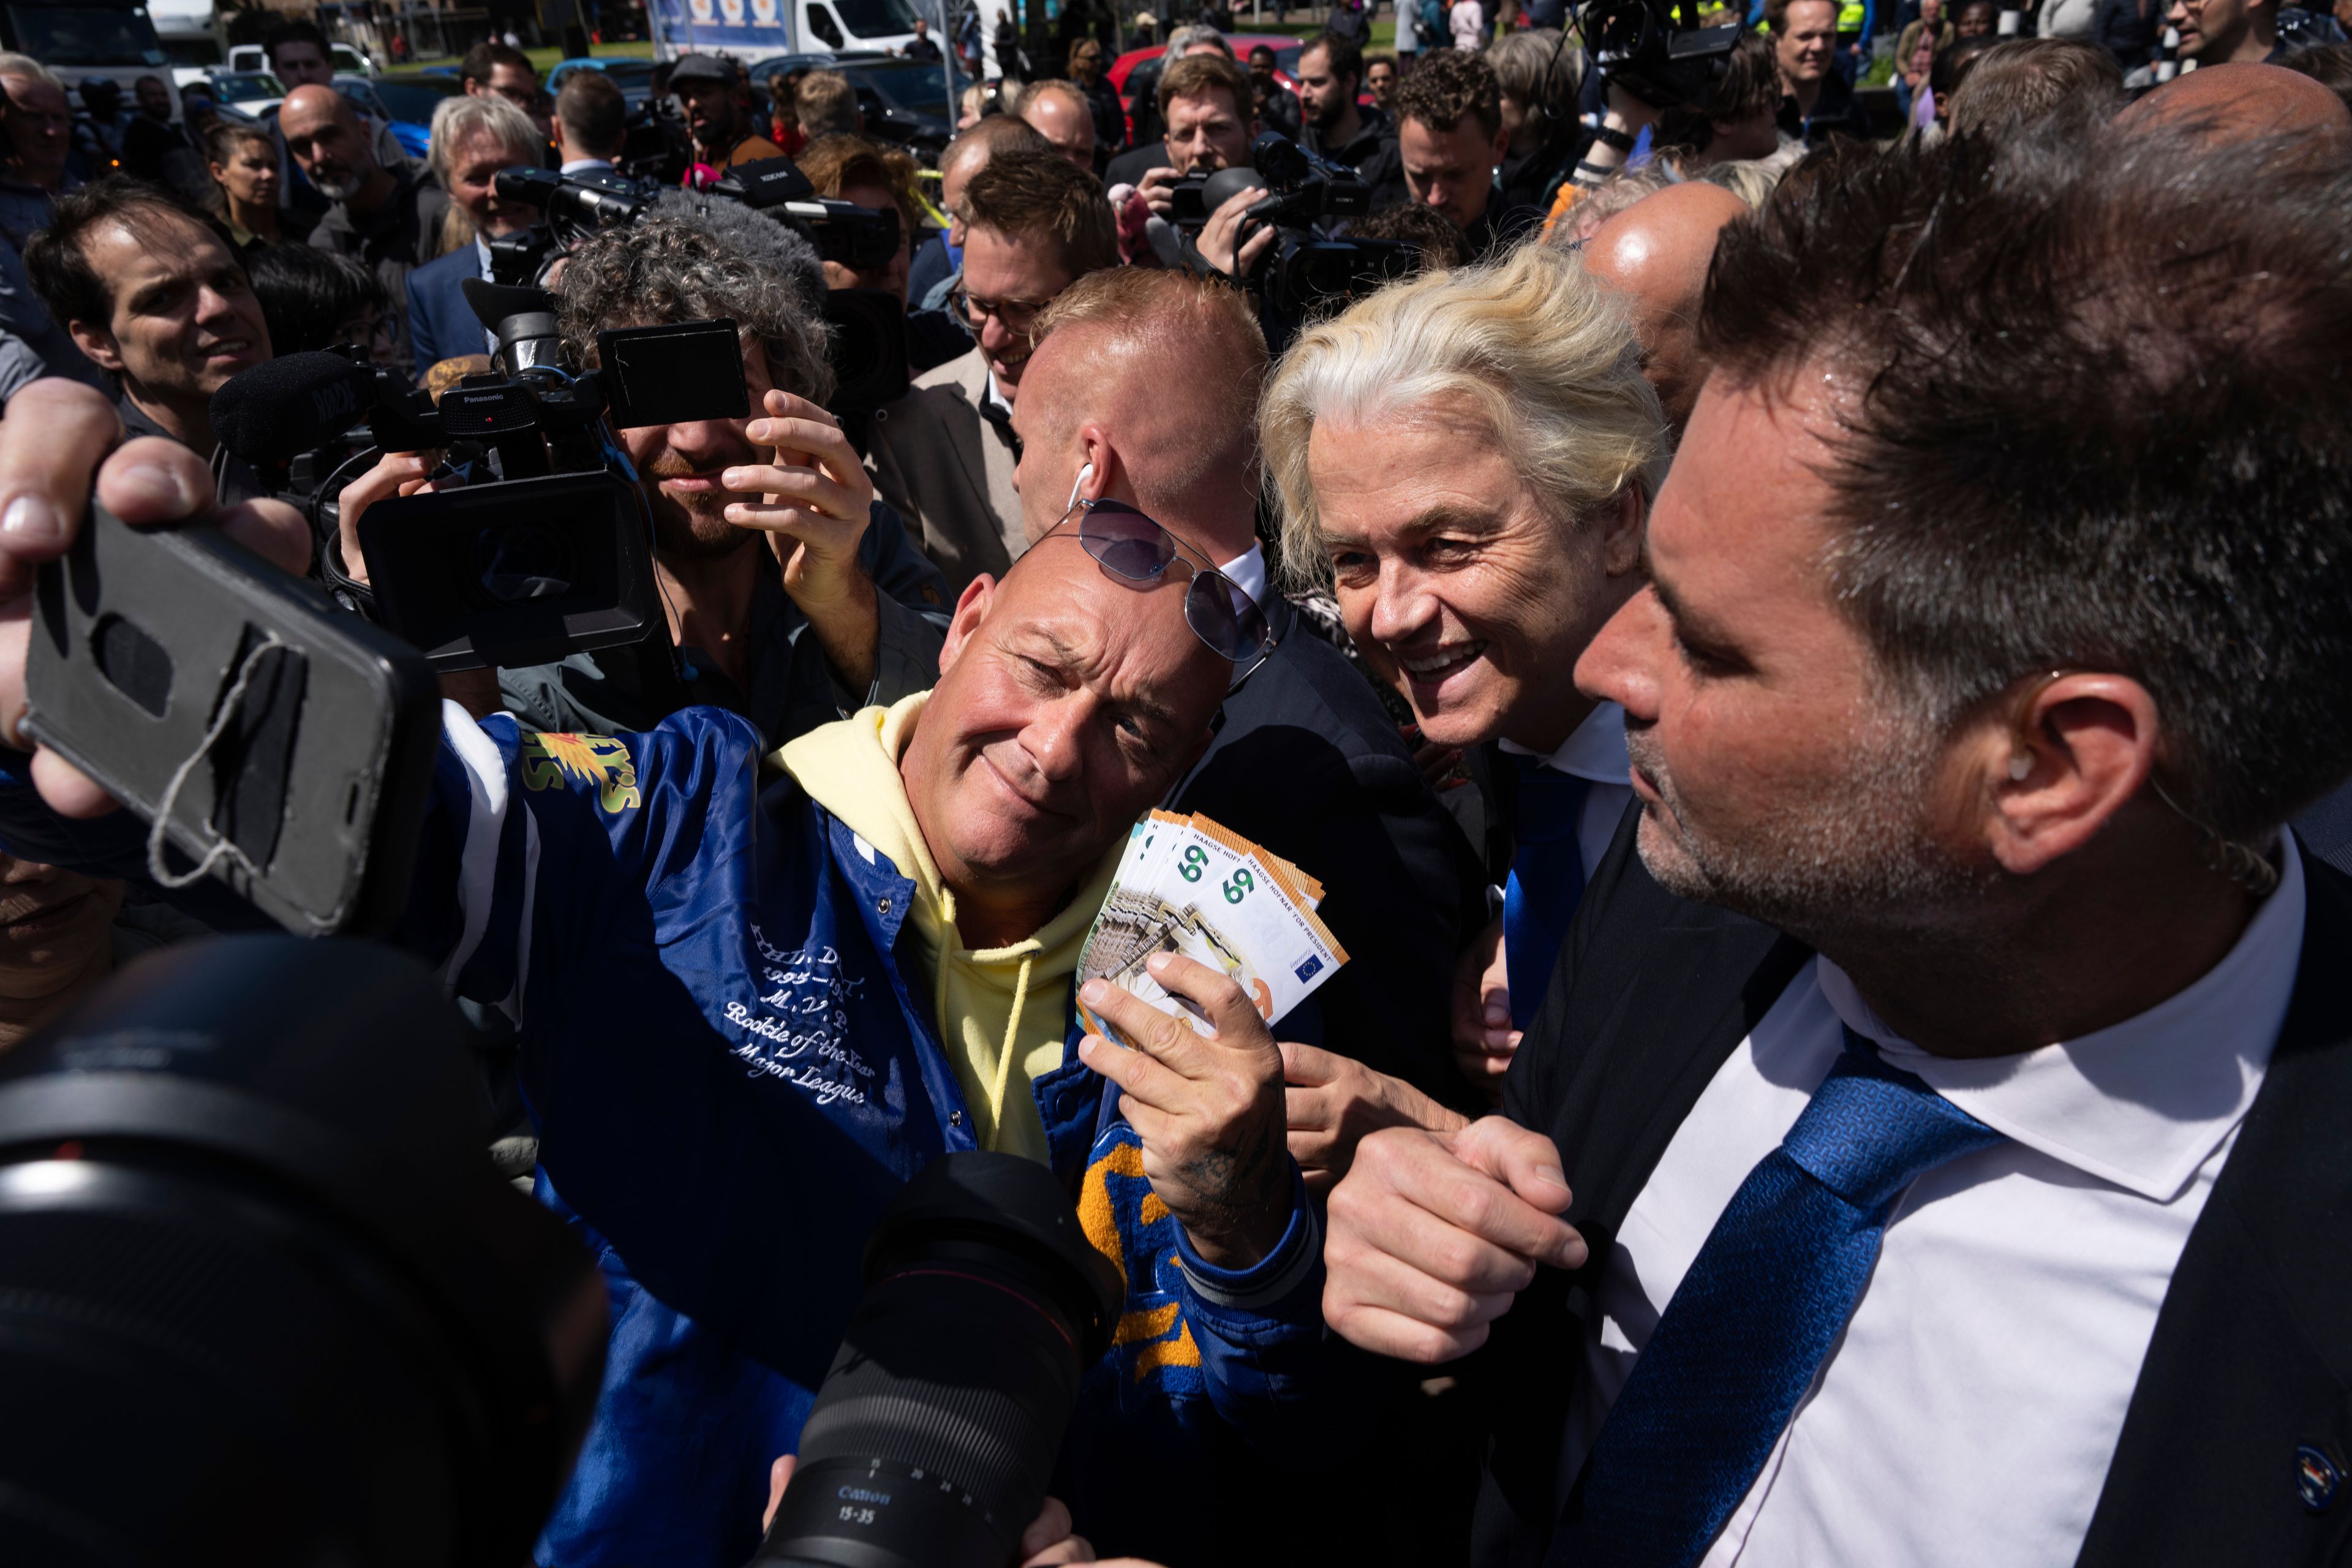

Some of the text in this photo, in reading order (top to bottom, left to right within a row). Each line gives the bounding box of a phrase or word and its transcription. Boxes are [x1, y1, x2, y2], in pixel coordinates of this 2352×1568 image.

[464, 393, 504, 404] Panasonic
[1194, 833, 1221, 853] HAAGSE
[1248, 858, 1271, 886] HAAGSE
[1269, 884, 1293, 913] HOFNAR
[723, 1001, 876, 1078] Rookie of the Year
[728, 1042, 865, 1105] Major League
[910, 1468, 924, 1480] 20
[837, 1484, 892, 1506] Canon
[839, 1505, 875, 1525] 15-35
